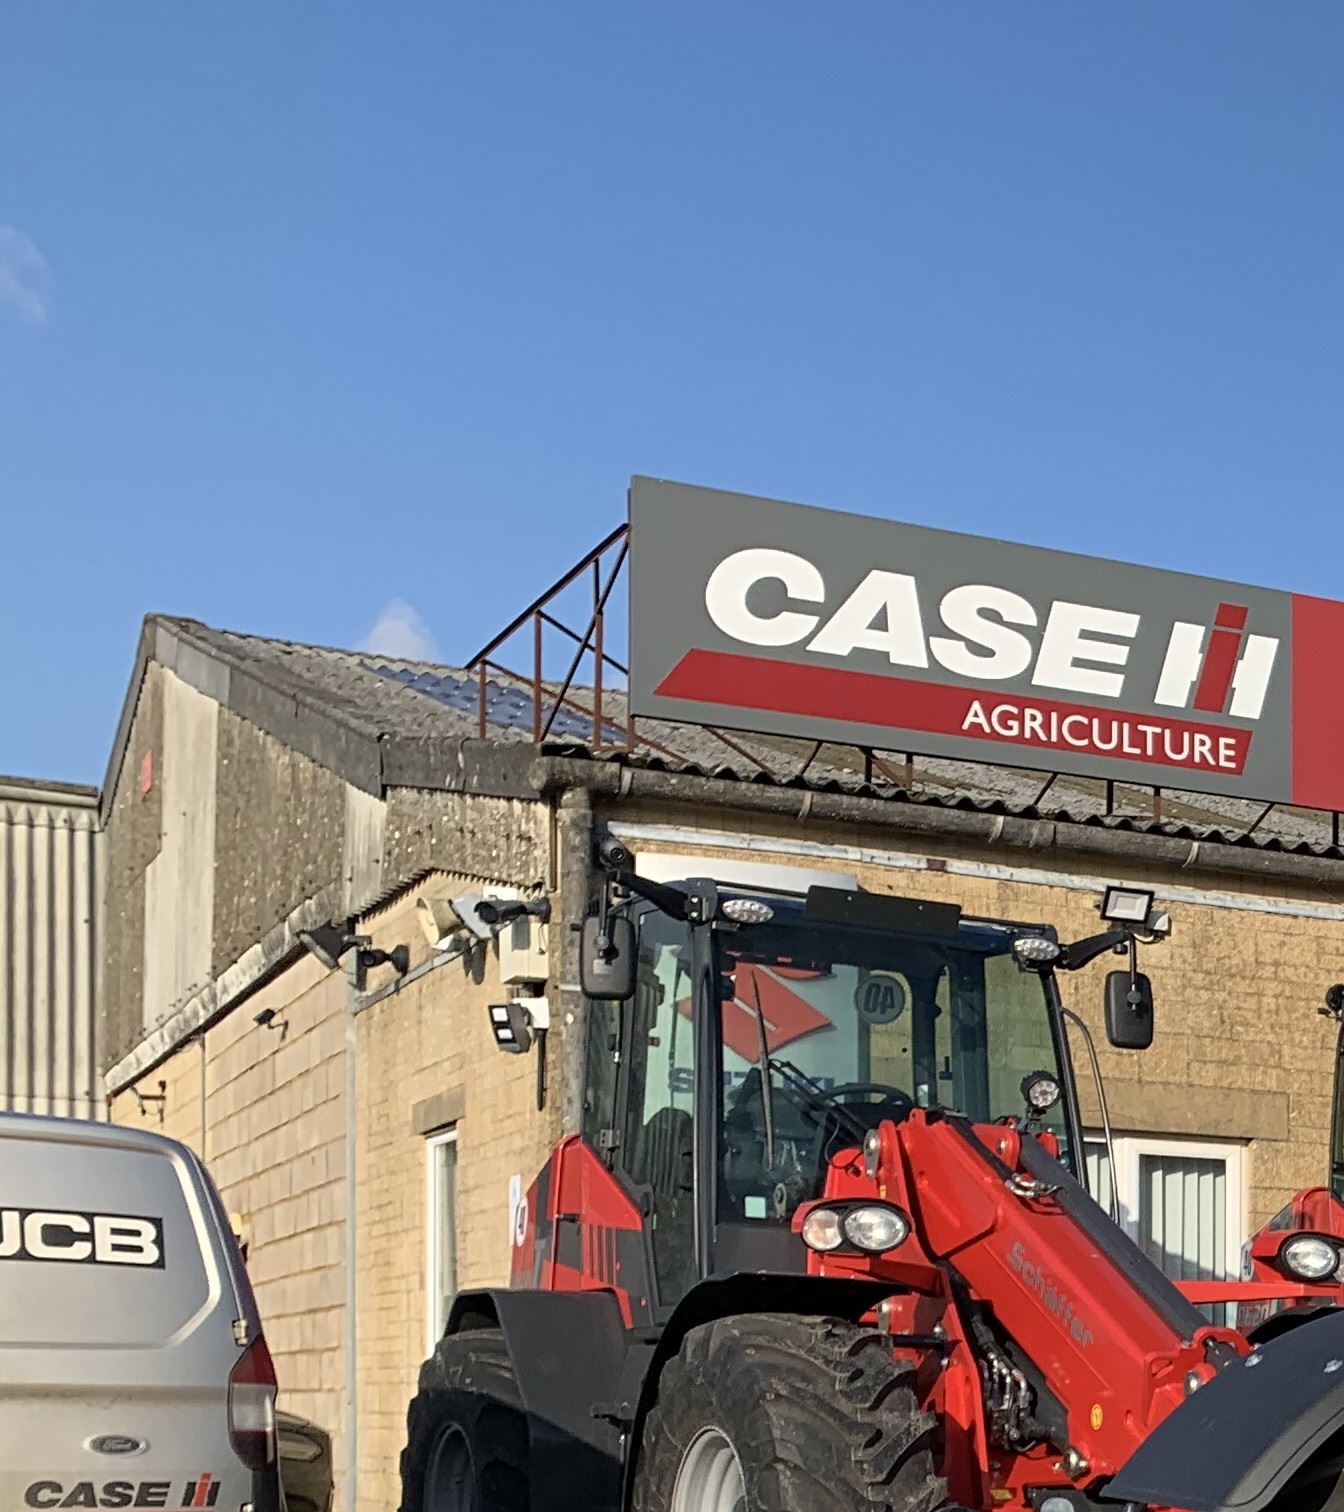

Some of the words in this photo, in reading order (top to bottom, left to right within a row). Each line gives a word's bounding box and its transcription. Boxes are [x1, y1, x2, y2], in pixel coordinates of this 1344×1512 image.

[705, 548, 1141, 698] CASE
[961, 700, 1238, 769] AGRICULTURE
[0, 1210, 160, 1265] JCB
[24, 1480, 172, 1509] CASE
